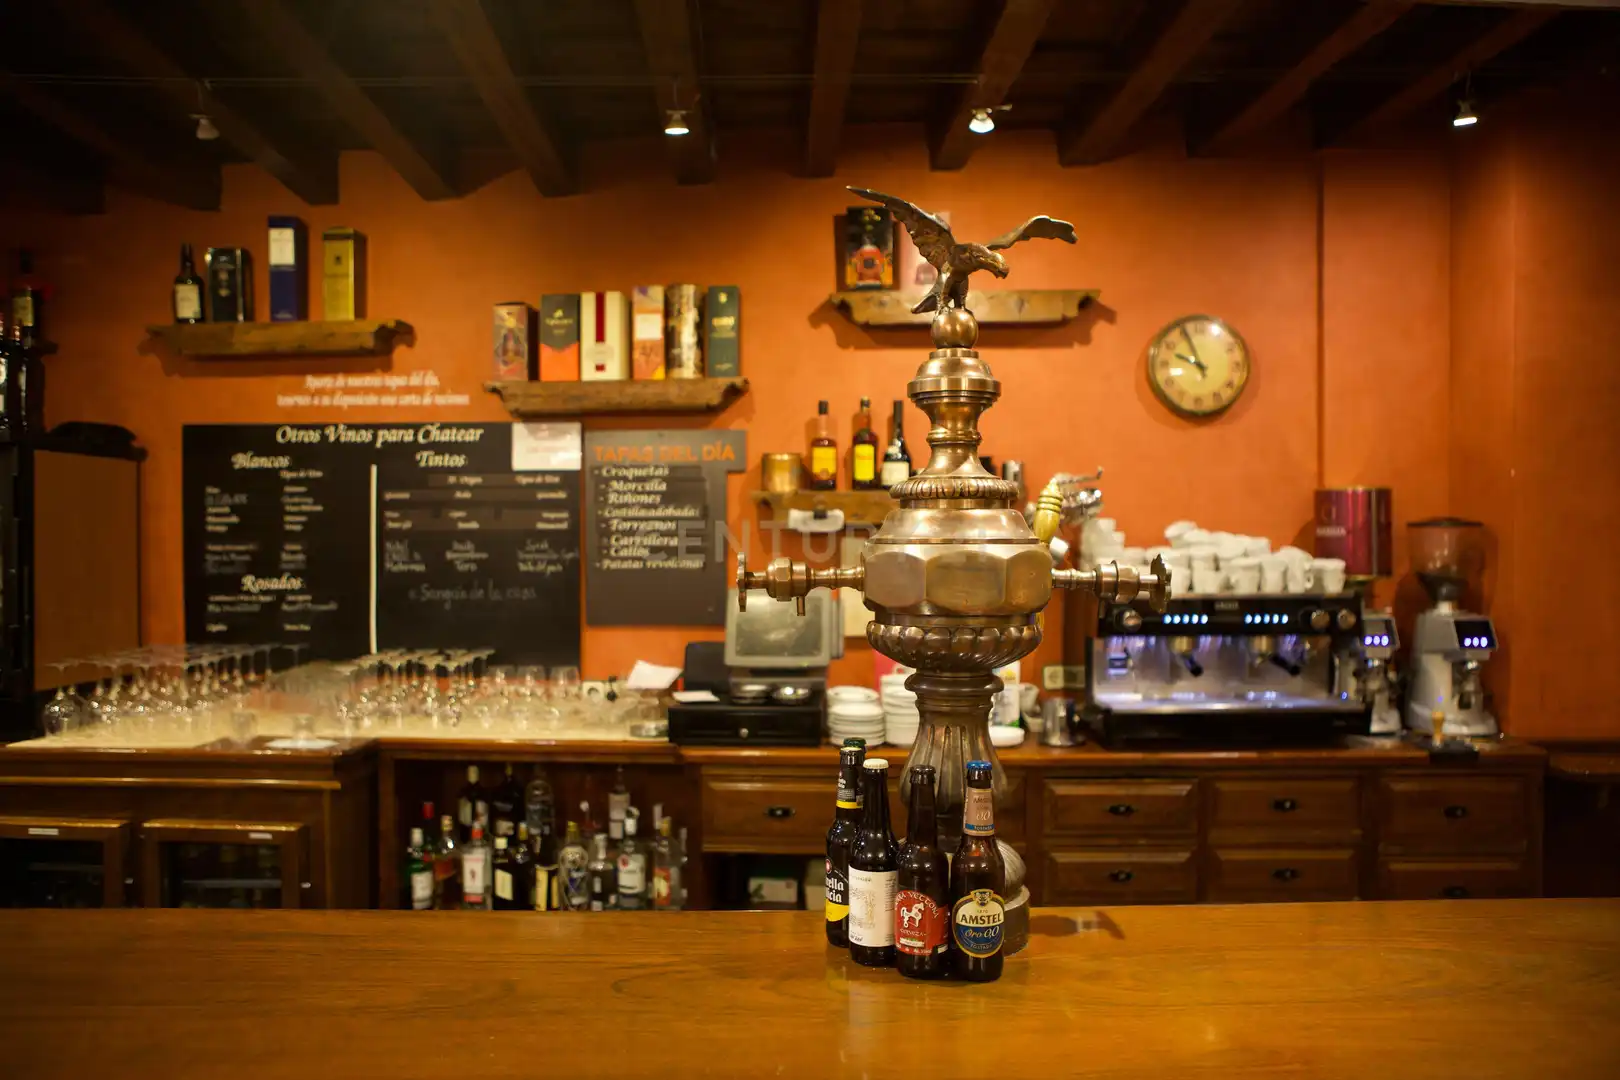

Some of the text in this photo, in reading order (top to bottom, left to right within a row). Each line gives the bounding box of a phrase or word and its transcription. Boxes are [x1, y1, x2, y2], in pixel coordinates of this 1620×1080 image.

[276, 422, 484, 448] Otros Vinos para Chatear
[415, 450, 467, 468] Tintos
[594, 440, 735, 461] TAPAS DEL DÍA
[231, 451, 290, 469] Blancos
[602, 466, 670, 480] Croquetas
[241, 574, 305, 593] Rosados
[960, 913, 1002, 925] AMSTEL
